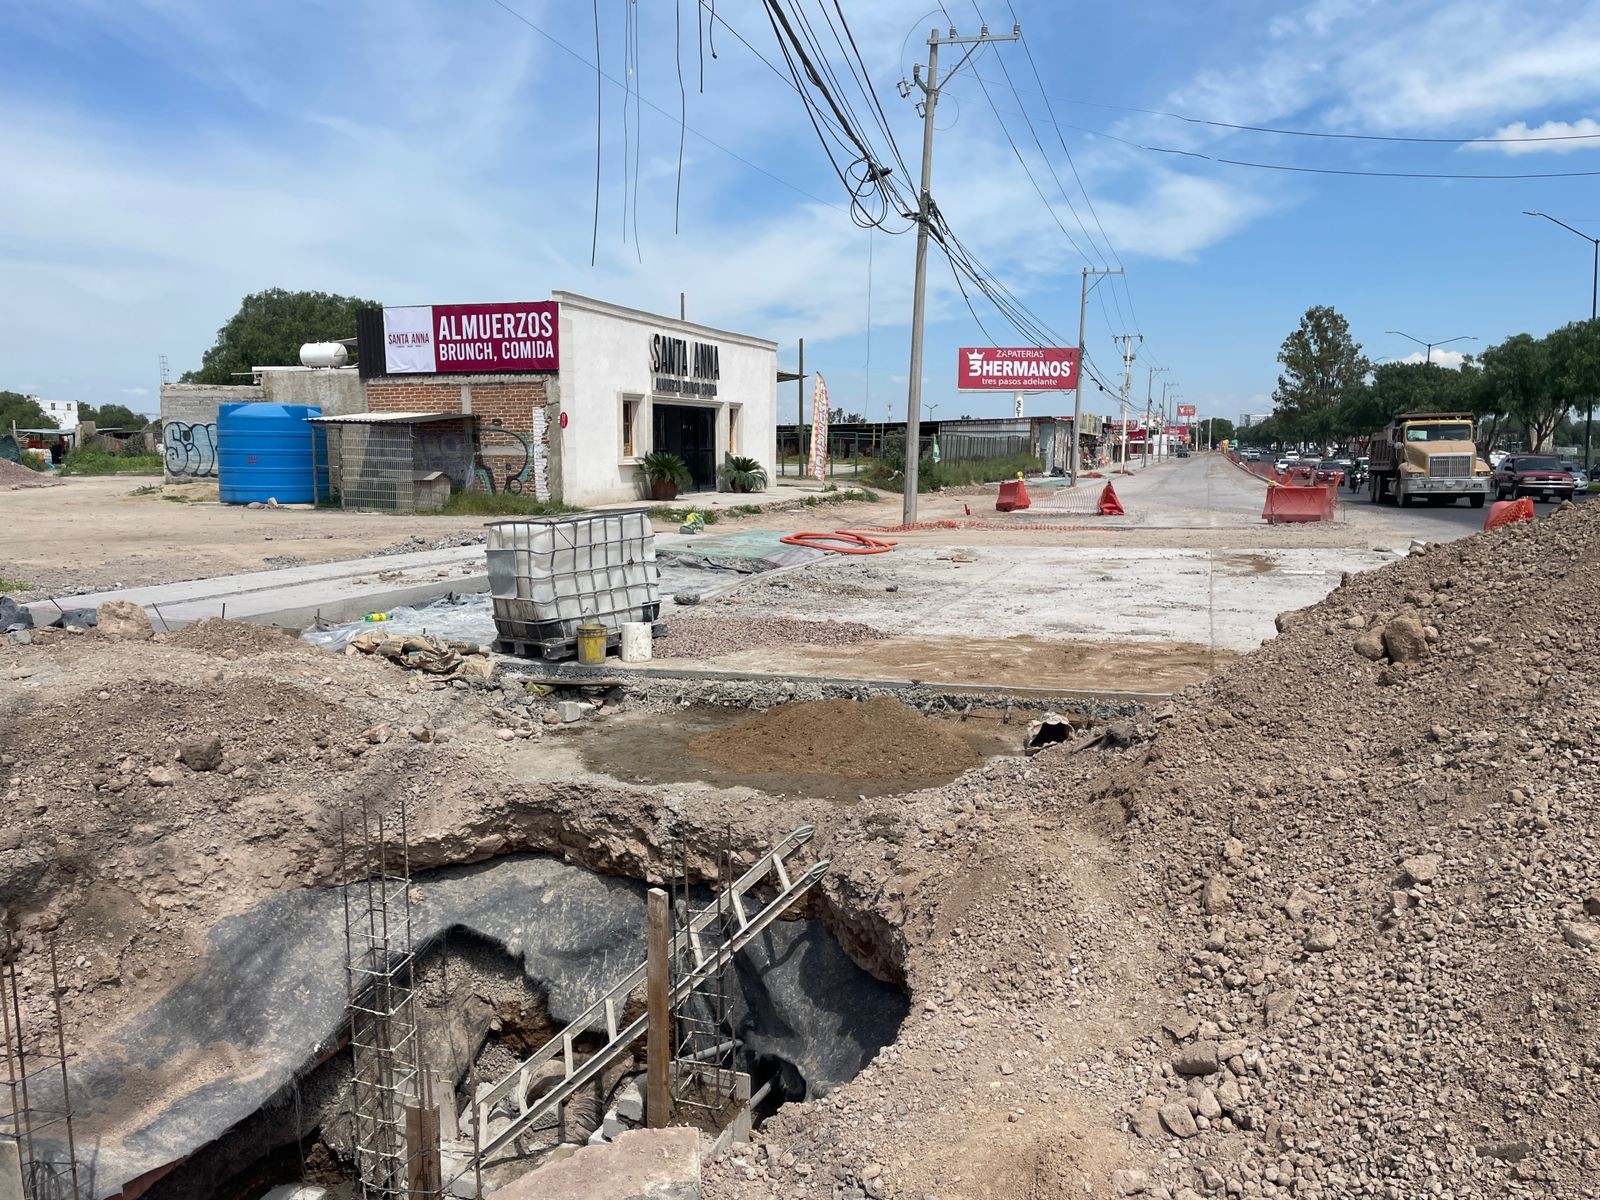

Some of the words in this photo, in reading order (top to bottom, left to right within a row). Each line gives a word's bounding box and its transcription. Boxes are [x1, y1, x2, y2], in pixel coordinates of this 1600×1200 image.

[438, 312, 553, 341] ALMUERZOS
[388, 333, 409, 345] SANTA
[411, 332, 430, 344] ANNA
[439, 342, 498, 362] BRUNCH,
[501, 340, 554, 359] COMIDA
[653, 333, 688, 377] SANTA
[693, 341, 720, 381] ANNA
[996, 349, 1044, 358] ZAPATERIAS
[998, 379, 1021, 387] pasos
[1023, 378, 1058, 386] adelante
